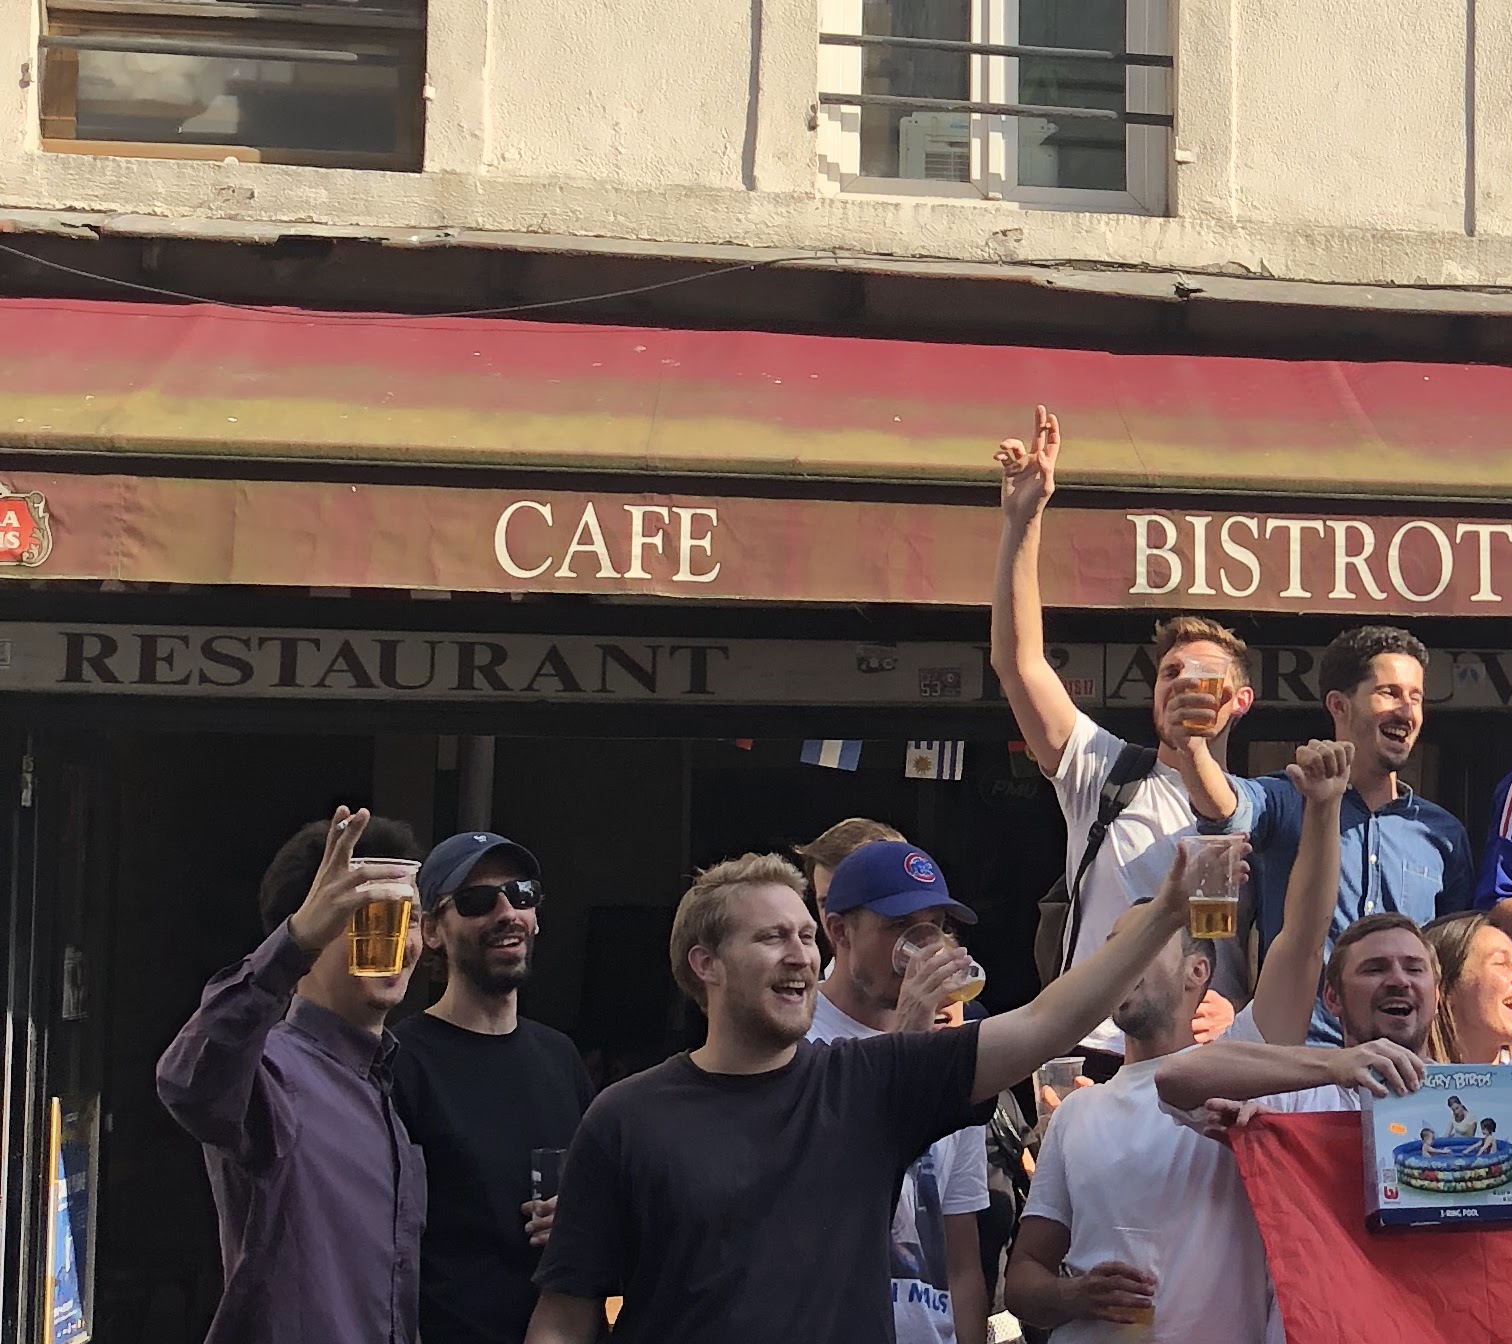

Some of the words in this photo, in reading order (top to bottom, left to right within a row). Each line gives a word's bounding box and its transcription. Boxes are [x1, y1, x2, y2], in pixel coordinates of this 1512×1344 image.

[494, 500, 722, 582] CAFE
[56, 631, 730, 696] RESTAURANT
[1452, 1072, 1492, 1090] BIRDS
